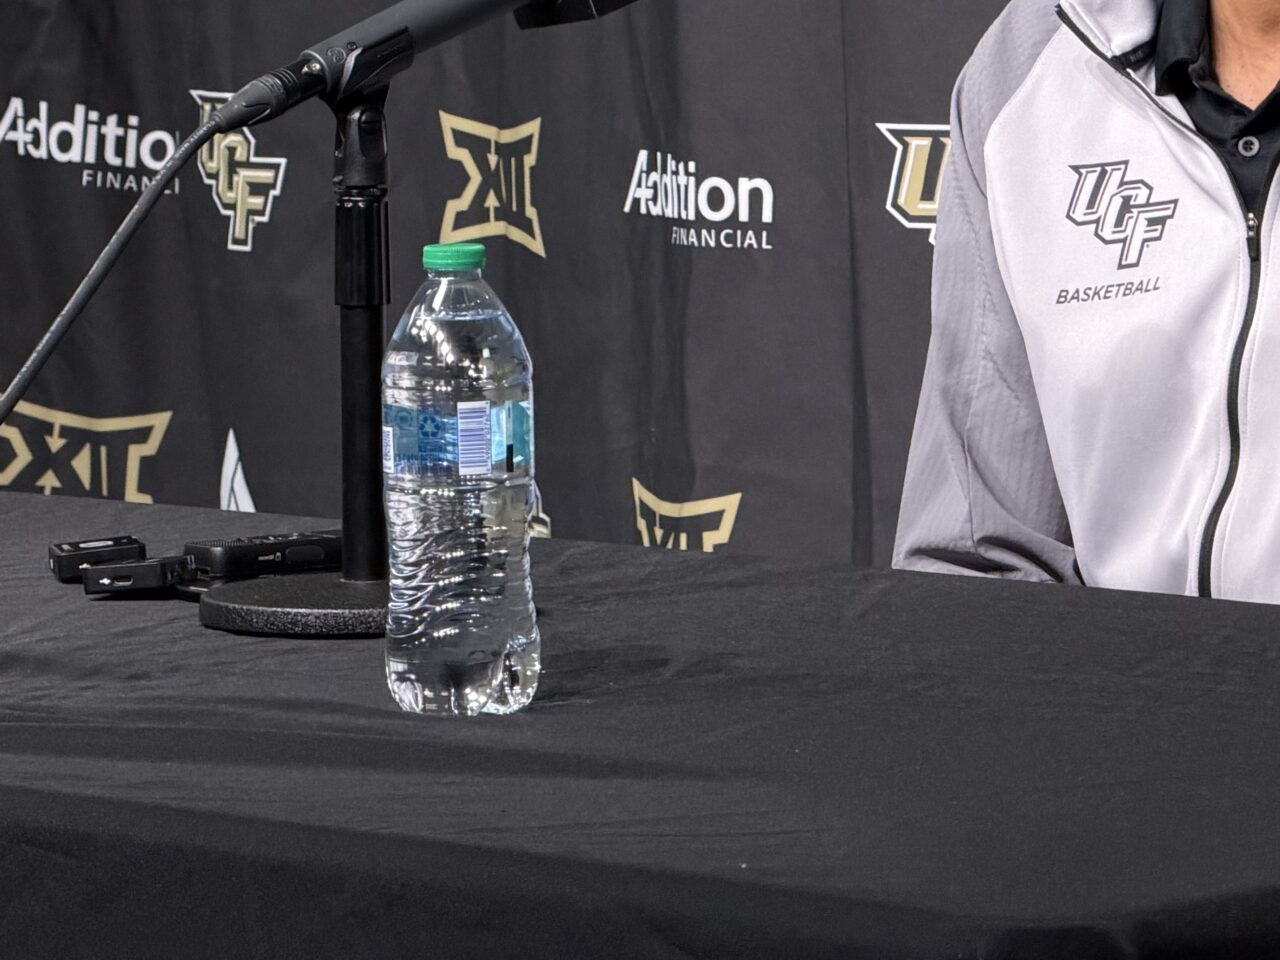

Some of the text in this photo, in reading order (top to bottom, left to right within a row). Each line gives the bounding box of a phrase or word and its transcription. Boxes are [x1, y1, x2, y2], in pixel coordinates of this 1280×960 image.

[0, 96, 178, 171] Additio
[438, 109, 547, 259] XII
[623, 149, 774, 223] Addition
[1065, 159, 1180, 271] UCF
[672, 226, 773, 250] FINANCIAL
[1056, 276, 1161, 305] BASKETBALL
